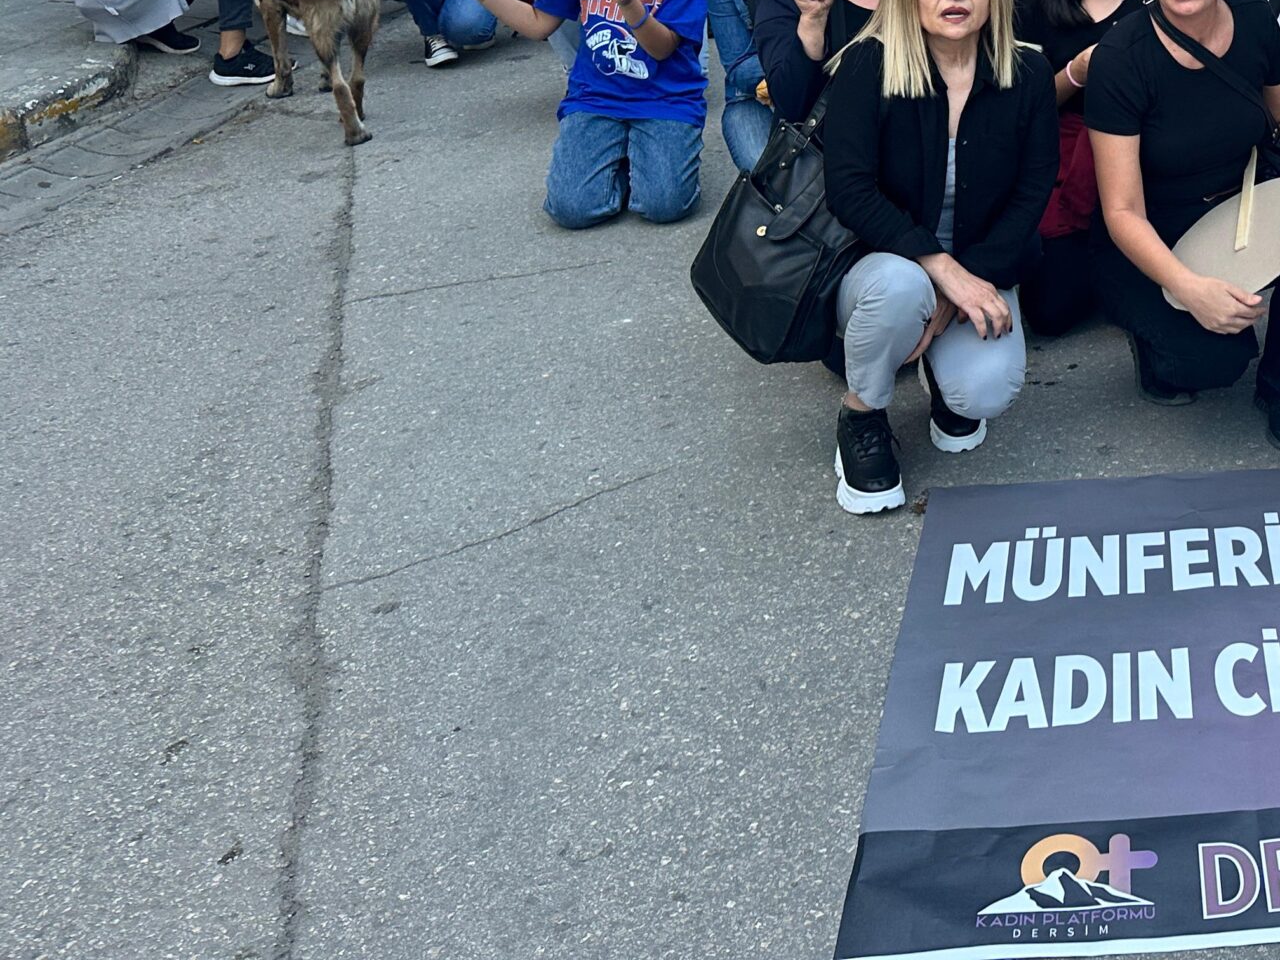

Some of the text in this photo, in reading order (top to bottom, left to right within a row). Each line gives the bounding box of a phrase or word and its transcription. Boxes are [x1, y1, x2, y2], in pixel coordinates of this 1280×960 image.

[934, 647, 1194, 734] KADIN
[976, 907, 1155, 928] KADIN PLATFORMU
